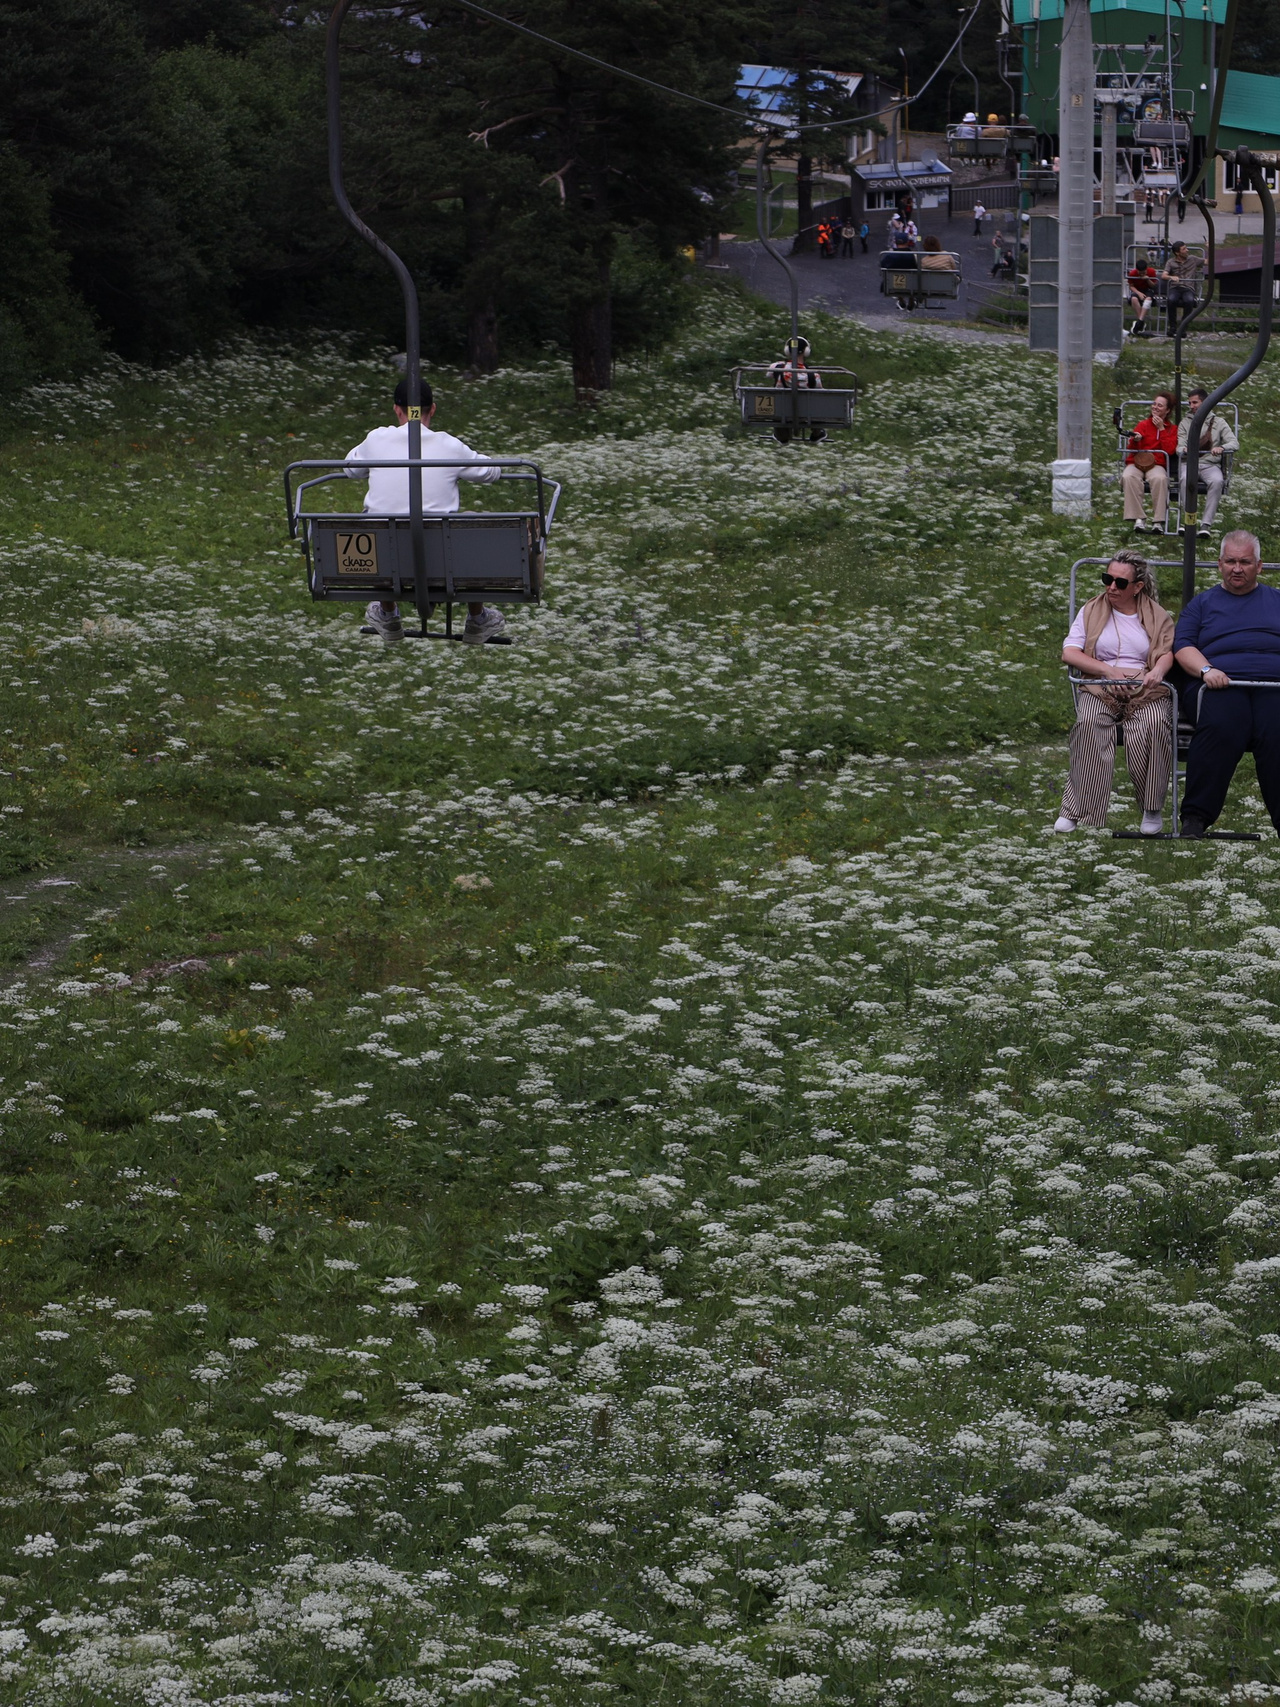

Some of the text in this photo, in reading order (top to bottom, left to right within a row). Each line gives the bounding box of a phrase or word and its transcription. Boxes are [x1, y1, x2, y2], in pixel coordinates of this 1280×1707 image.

[1075, 94, 1081, 103] 3
[894, 274, 905, 283] 72
[757, 395, 773, 407] 71
[410, 409, 419, 418] 72
[339, 533, 372, 555] 70
